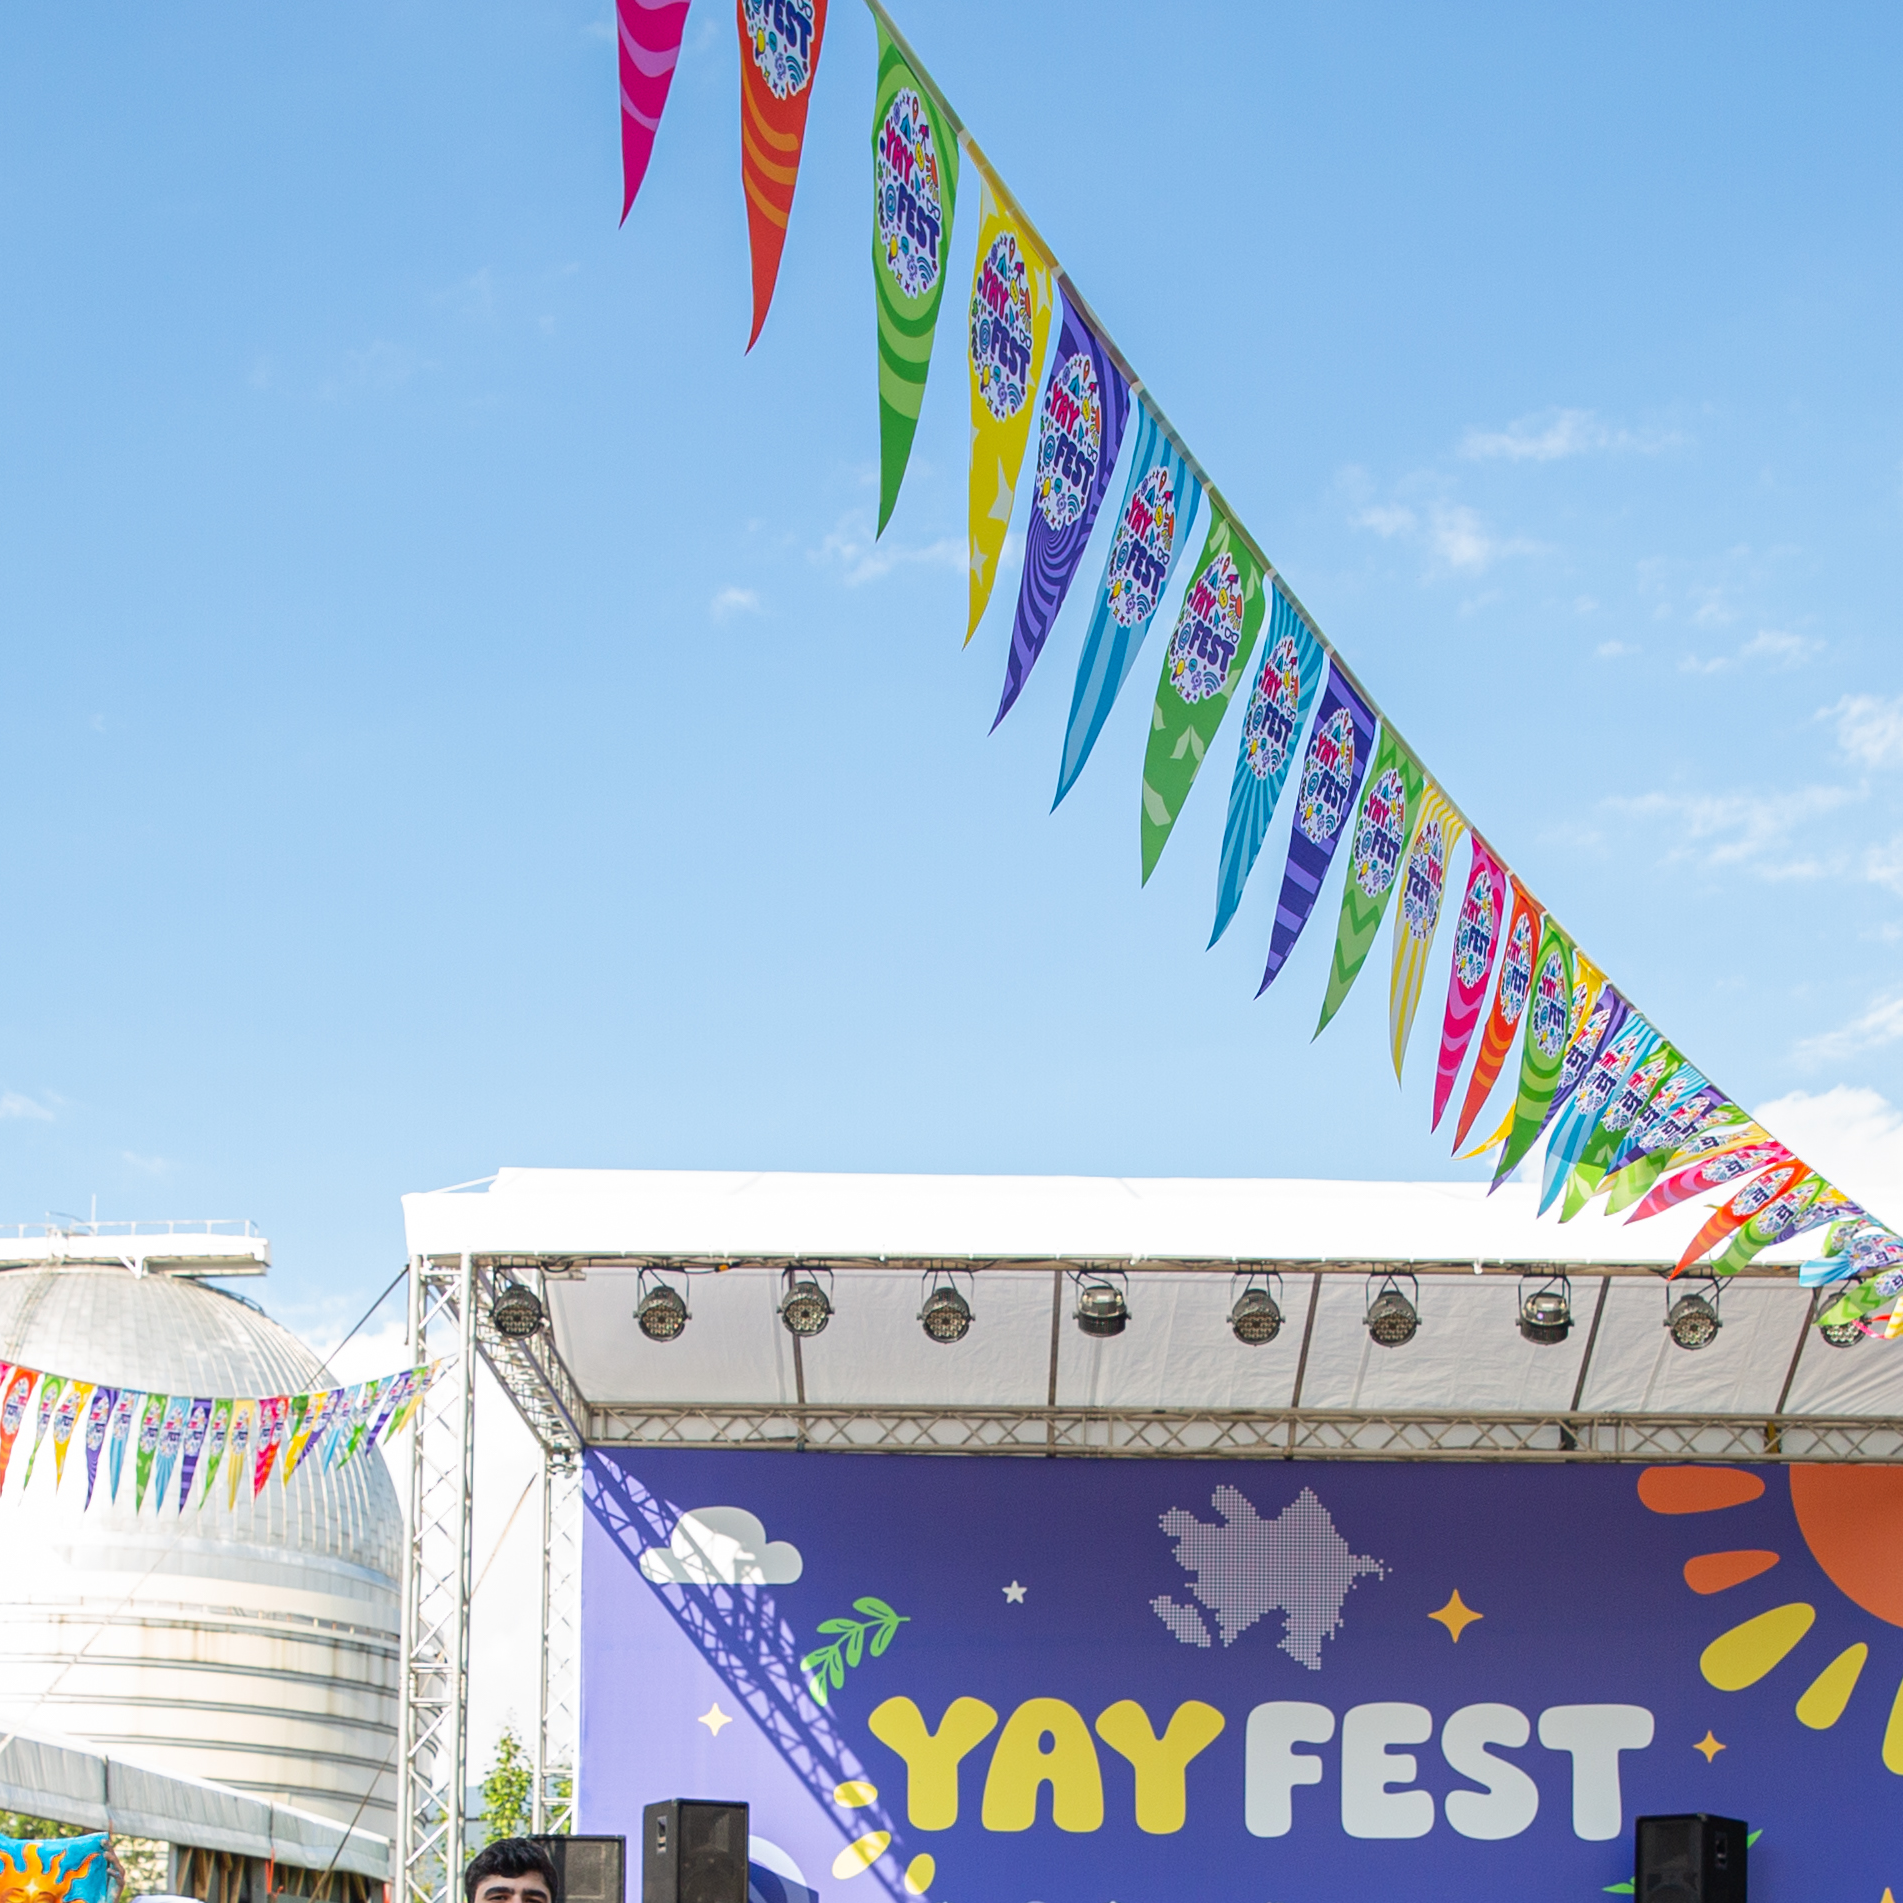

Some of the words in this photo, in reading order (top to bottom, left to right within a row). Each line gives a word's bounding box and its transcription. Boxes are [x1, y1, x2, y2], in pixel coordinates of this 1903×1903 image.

[885, 120, 915, 185] YAY
[981, 258, 1009, 316] YAY
[1049, 384, 1080, 431] YAY
[1128, 492, 1154, 534] YAY
[1191, 579, 1216, 619] YAY
[1260, 663, 1282, 703] YAY
[1316, 730, 1339, 767] YAY
[1366, 784, 1390, 826] YAY
[868, 1694, 1227, 1833] YAY
[1244, 1700, 1655, 1839] FEST
